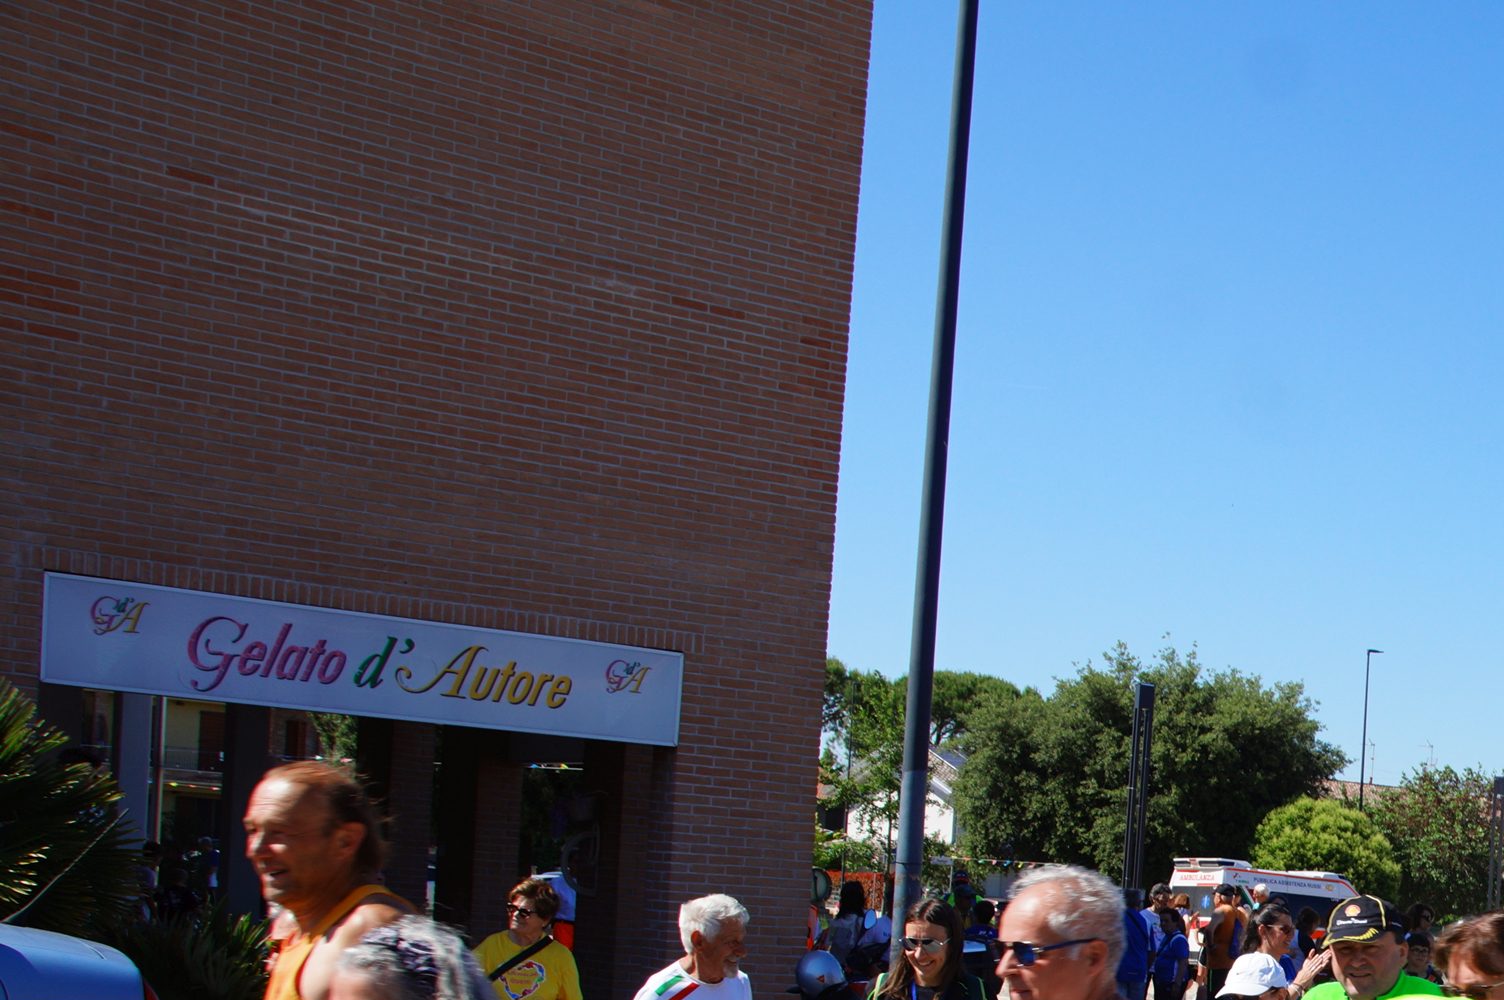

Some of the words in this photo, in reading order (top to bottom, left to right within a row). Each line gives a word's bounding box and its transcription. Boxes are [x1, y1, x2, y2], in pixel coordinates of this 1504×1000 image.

[186, 616, 347, 692] Gelato
[1179, 873, 1215, 881] AMBULANZA
[1253, 876, 1278, 885] PUBBLICA
[1278, 879, 1307, 887] ASSISTENZA
